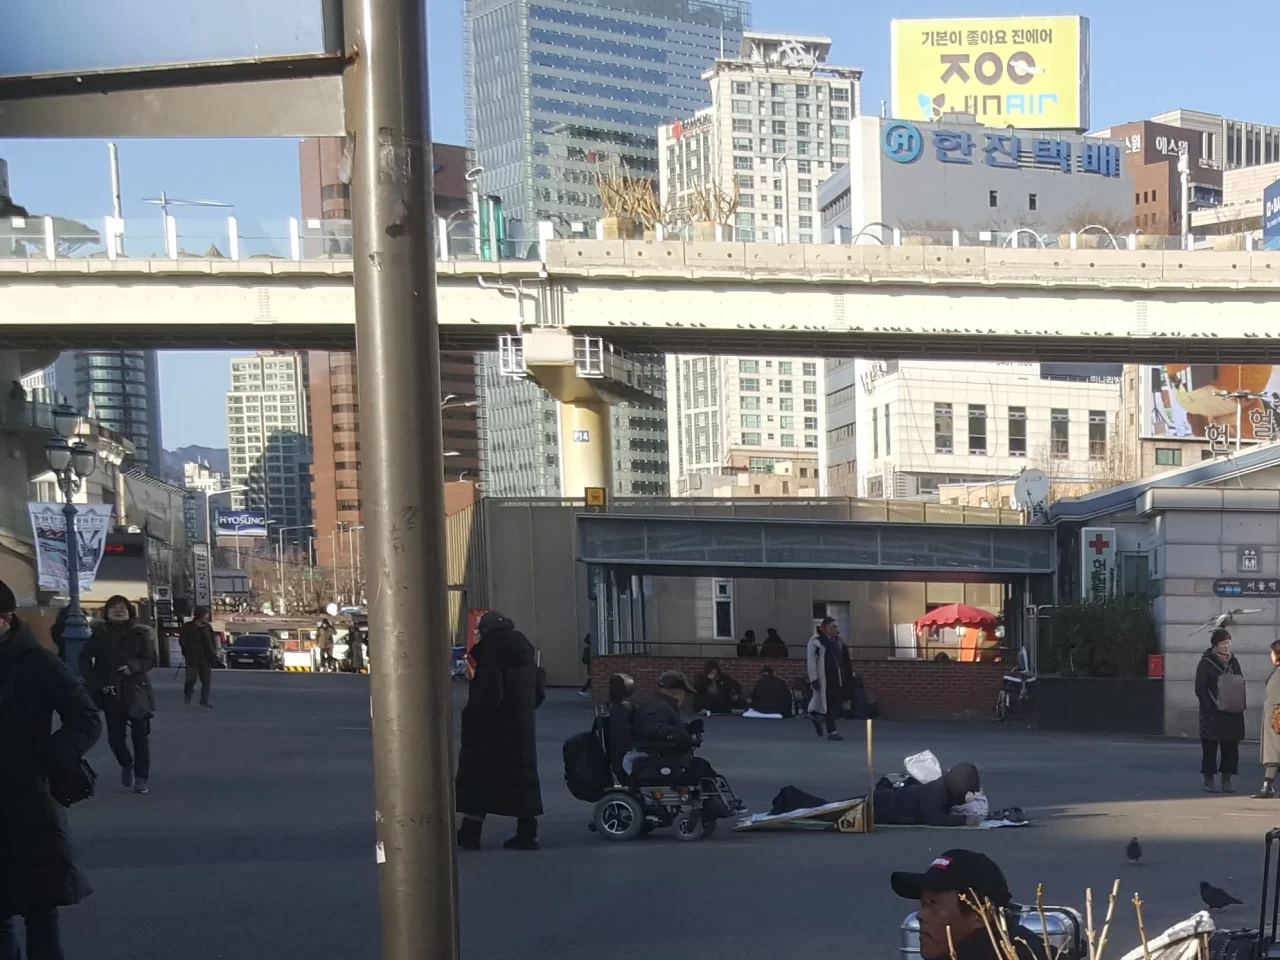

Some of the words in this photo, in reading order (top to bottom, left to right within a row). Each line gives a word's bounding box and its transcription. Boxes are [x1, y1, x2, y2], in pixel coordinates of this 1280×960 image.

[921, 30, 962, 46] 기본이
[966, 30, 1008, 45] 좋아요
[1011, 28, 1053, 44] 진에어
[932, 130, 1121, 178] 한진택배
[1155, 136, 1188, 158] 에스원
[574, 431, 589, 441] P14
[219, 515, 265, 525] HYOSUNG
[1247, 581, 1276, 591] 서울역
